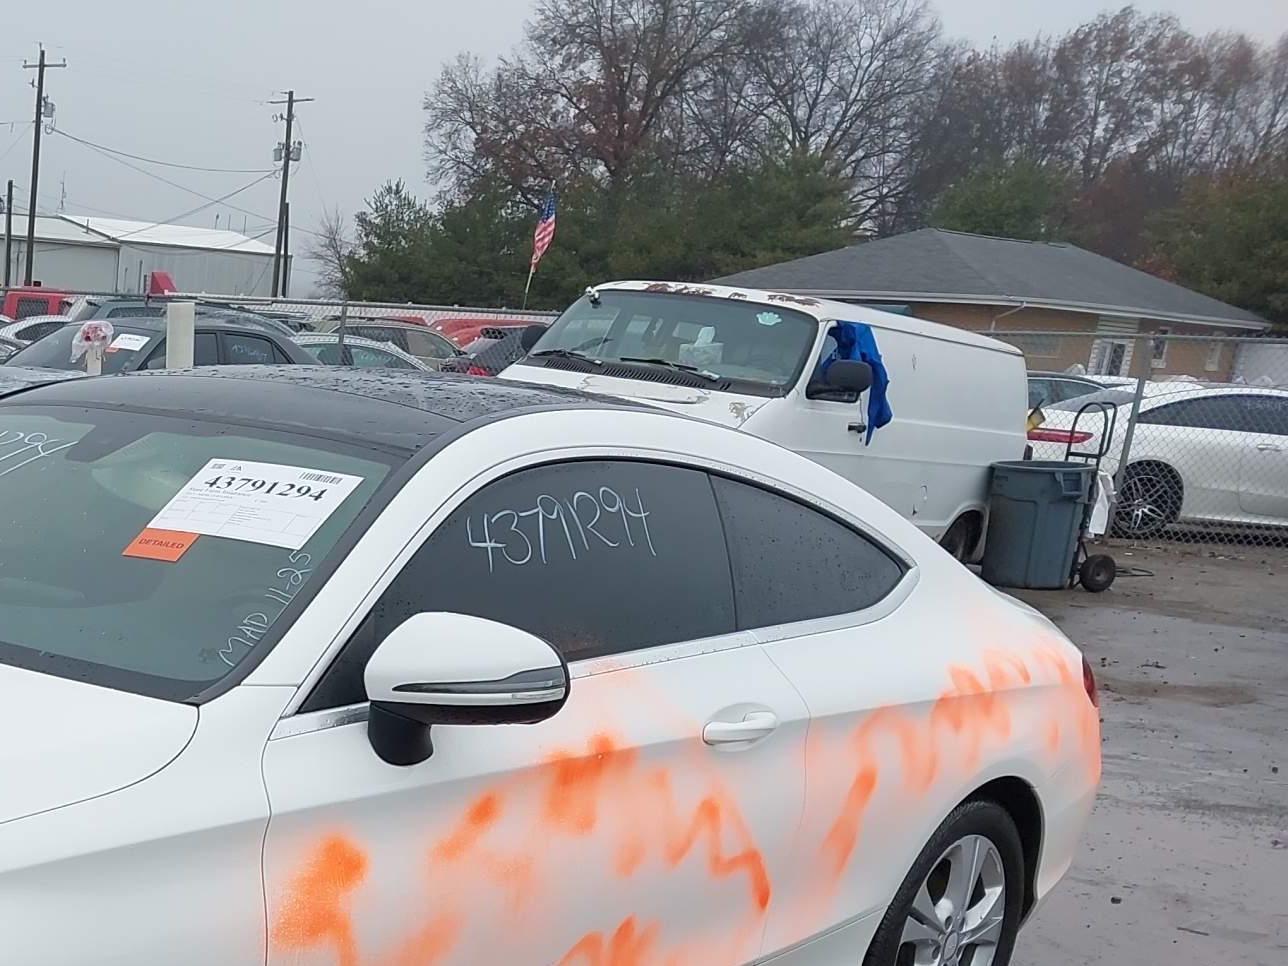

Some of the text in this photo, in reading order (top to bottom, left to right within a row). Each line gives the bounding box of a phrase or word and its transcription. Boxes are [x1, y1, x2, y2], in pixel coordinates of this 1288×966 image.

[204, 475, 329, 502] 43791294
[138, 538, 185, 549] DETAILED
[218, 550, 314, 667] MAD 11-25
